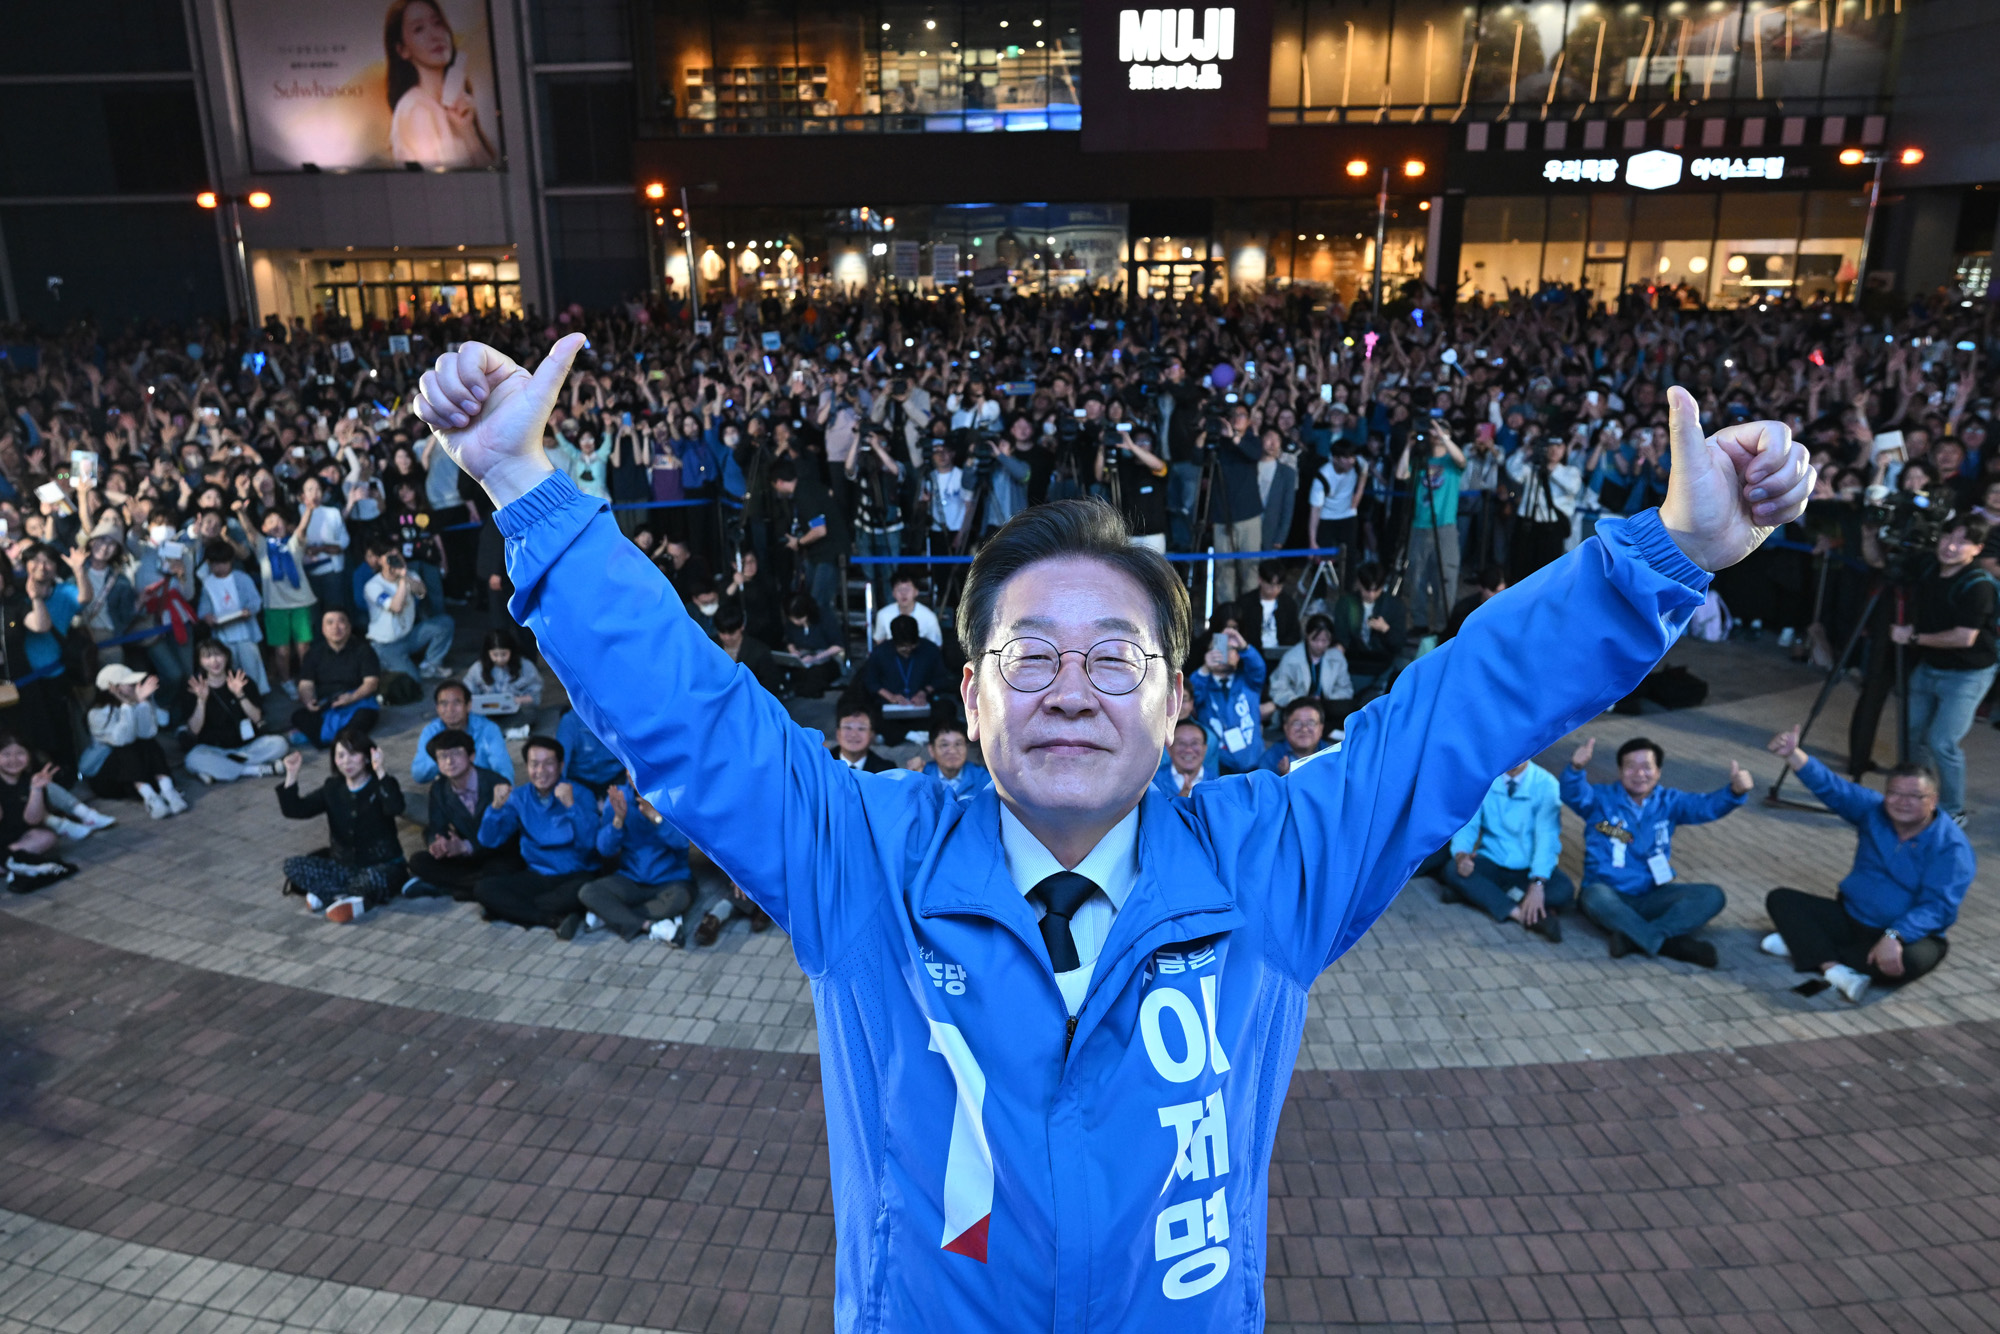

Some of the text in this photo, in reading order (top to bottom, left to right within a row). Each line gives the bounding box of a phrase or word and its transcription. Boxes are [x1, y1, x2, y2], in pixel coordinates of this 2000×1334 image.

[1119, 7, 1235, 62] MUJI
[1543, 156, 1785, 183] 우리목장 아이스크림
[927, 1015, 995, 1265] 1
[1139, 974, 1232, 1300] 이재명
